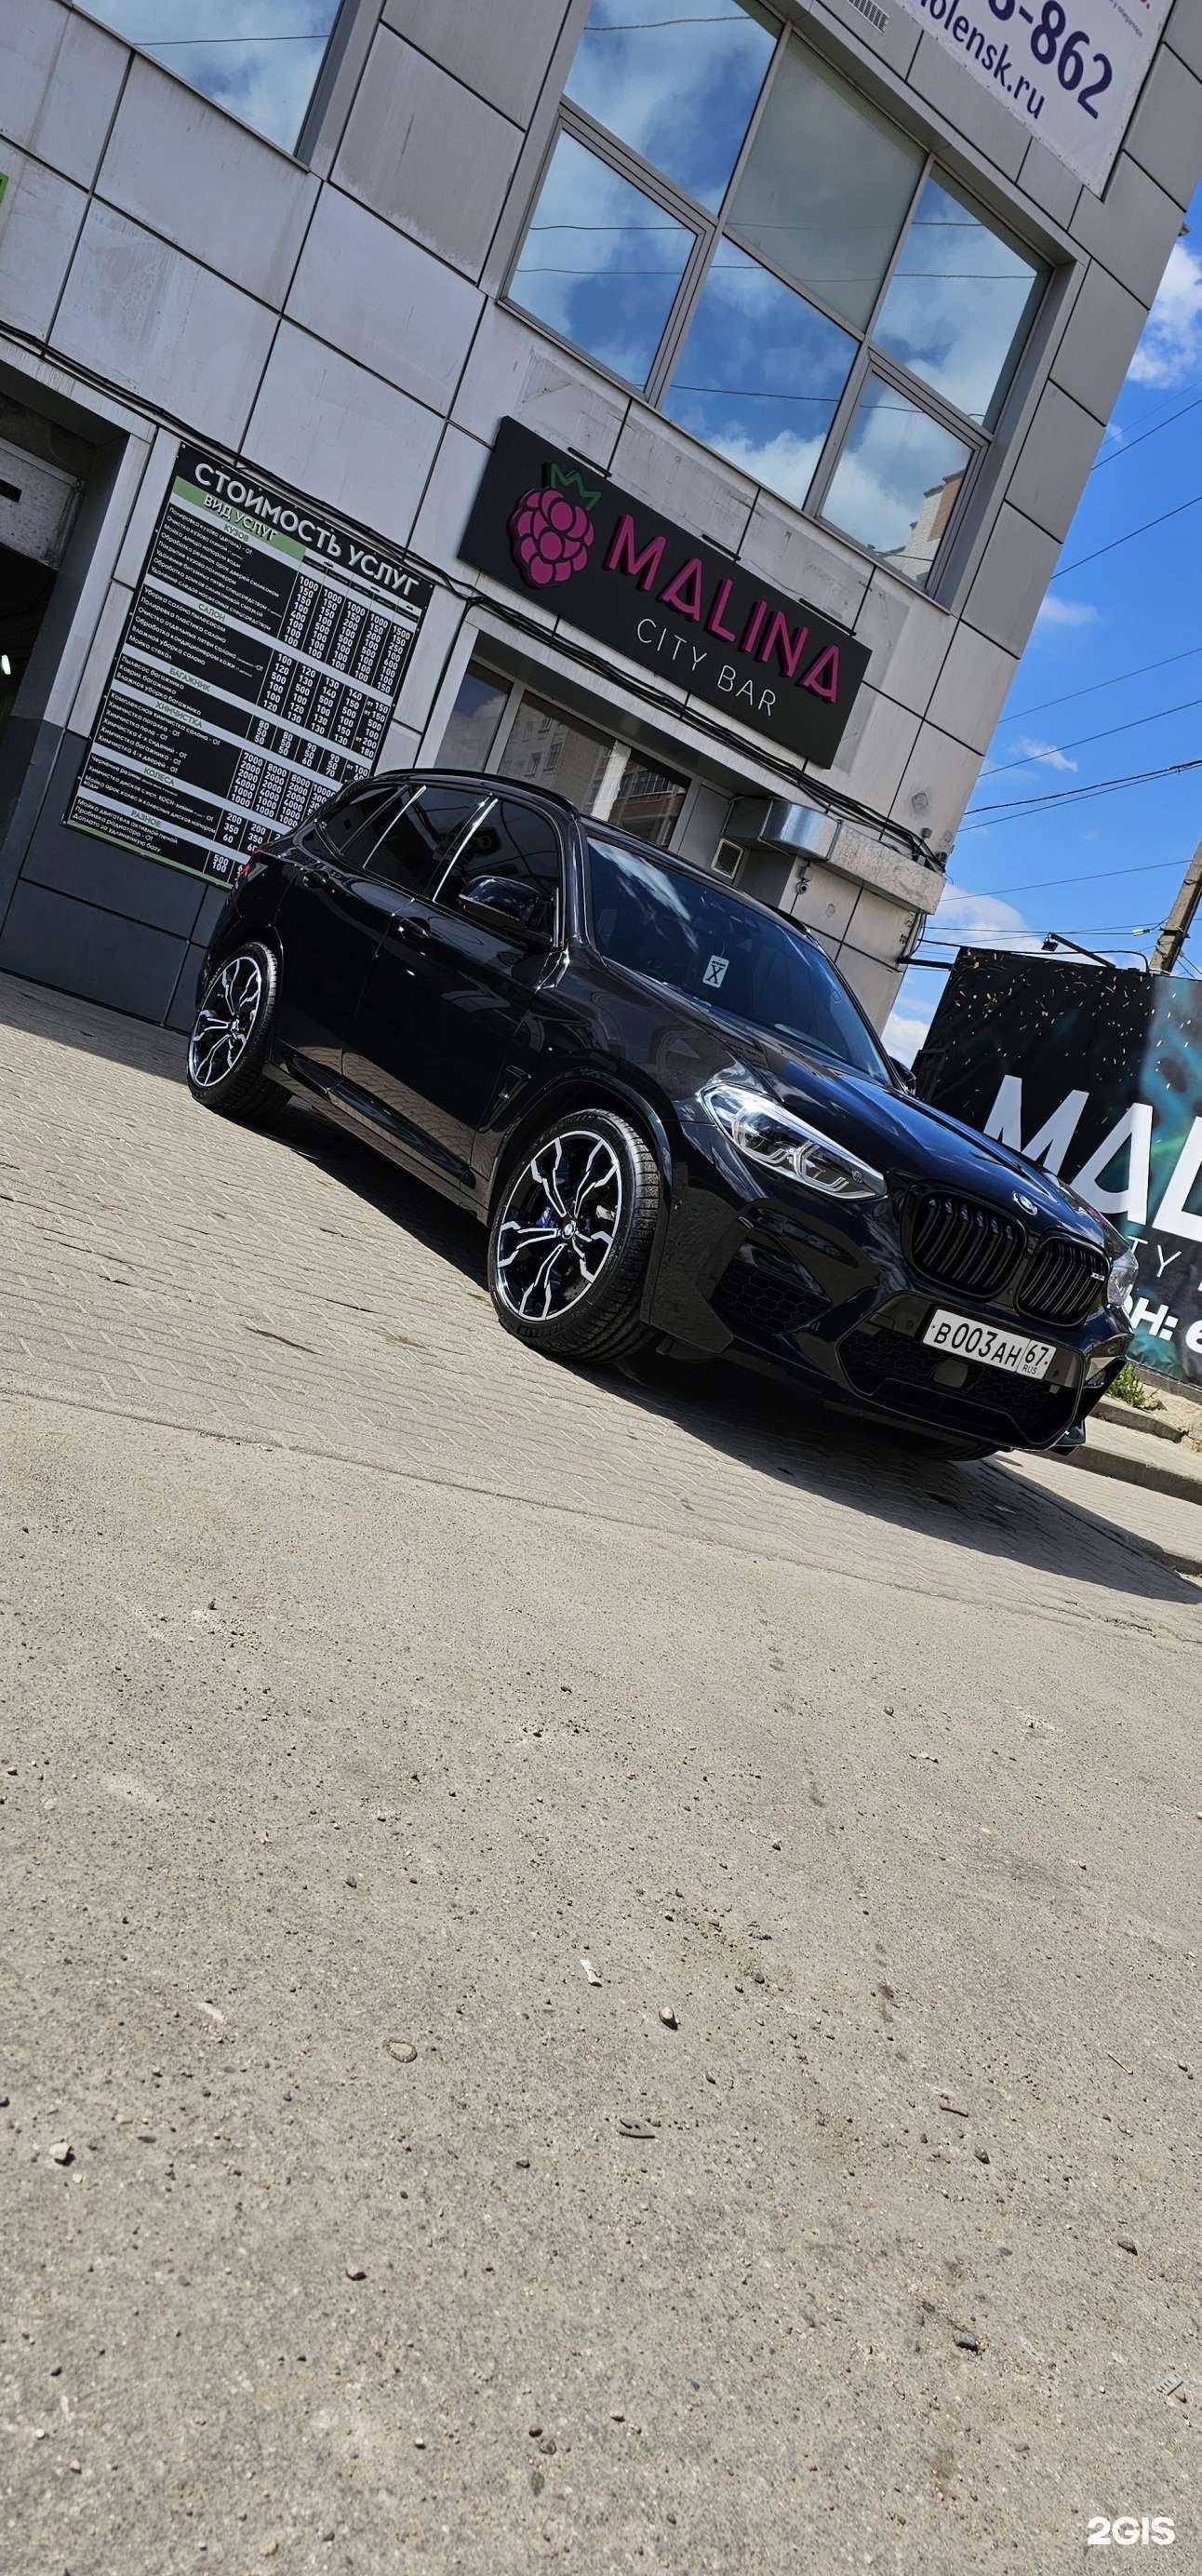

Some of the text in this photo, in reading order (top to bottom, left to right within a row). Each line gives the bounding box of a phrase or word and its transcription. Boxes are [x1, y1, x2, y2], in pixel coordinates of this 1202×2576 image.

[920, 0, 1045, 120] olensk.ru
[192, 459, 419, 599] СТОИМОСТЬ УСЛУГ
[202, 493, 277, 543] ВИД УСЛУГ
[222, 523, 249, 543] КУЗОВ
[197, 602, 225, 622] САЛОН
[296, 593, 403, 655] 150 150 200 200 250
[298, 575, 318, 592] 1000
[322, 587, 342, 604] 1000
[346, 600, 366, 616] 1000
[369, 612, 388, 628] 1000
[392, 624, 410, 640] 1500
[298, 584, 406, 647] 150 150 150 150 150
[603, 515, 840, 704] MALINA
[287, 617, 395, 678] 100 100 100 100 100
[290, 609, 306, 623] 400
[314, 622, 329, 635] 500
[338, 634, 353, 647] 500
[361, 645, 376, 659] 500
[383, 657, 398, 670] 600
[293, 601, 308, 615] 100
[316, 613, 332, 627] 100
[341, 625, 355, 639] 100
[363, 637, 379, 651] 100
[386, 650, 401, 663] 100
[283, 633, 391, 693] 100 100 100 100 150
[285, 625, 393, 686] 100 100 100 100 100
[636, 618, 777, 718] CITY BAR
[169, 666, 210, 691] БАГАЖНИК
[274, 662, 289, 676] 120
[298, 674, 313, 687] 130
[321, 685, 337, 699] 140
[344, 697, 359, 710] 150
[370, 710, 385, 723] 150
[276, 652, 292, 666] 100
[300, 664, 316, 678] 120
[324, 677, 340, 690] 130
[347, 688, 363, 701] 140
[374, 701, 388, 714] 150
[155, 701, 203, 728] ХИМЧИСТКА
[264, 690, 280, 703] 100
[288, 701, 304, 715] 120
[313, 713, 327, 726] 130
[335, 723, 351, 737] 150
[362, 736, 377, 749] 200
[268, 680, 380, 740] 100 100 100 100 100
[271, 671, 381, 731] 500 500 500 500 500
[256, 727, 267, 738] 50
[279, 738, 291, 749] 50
[303, 749, 314, 759] 50
[327, 759, 338, 771] 50
[258, 719, 269, 731] 80
[282, 731, 293, 742] 80
[305, 742, 317, 753] 90
[328, 753, 340, 763] 90
[354, 764, 368, 776] 100
[261, 699, 374, 758] 120 130 130 130 180
[143, 767, 175, 785] КОЛЕСА
[242, 751, 263, 767] 7000
[266, 762, 287, 777] 8000
[290, 773, 311, 788] 8000
[253, 733, 336, 777] 50 50 60 70
[234, 776, 256, 791] 4000
[259, 786, 279, 801] 4000
[283, 798, 302, 812] 4000
[237, 768, 305, 804] 2000 2000 2000
[239, 759, 260, 775] 2000
[264, 771, 285, 785] 2000
[287, 782, 308, 796] 2000
[130, 810, 161, 827] РАЗНОЕ
[225, 812, 266, 835] 200 200
[229, 792, 250, 808] 1000
[253, 803, 274, 818] 1000
[232, 785, 253, 799] 1000
[256, 795, 276, 810] 1000
[280, 805, 300, 820] 1000
[221, 832, 234, 843] 60
[222, 822, 239, 835] 350
[247, 832, 263, 844] 350
[210, 861, 227, 873] 100
[212, 853, 229, 866] 500
[1022, 1365, 1038, 1375] RUS
[1025, 1344, 1049, 1366] 67
